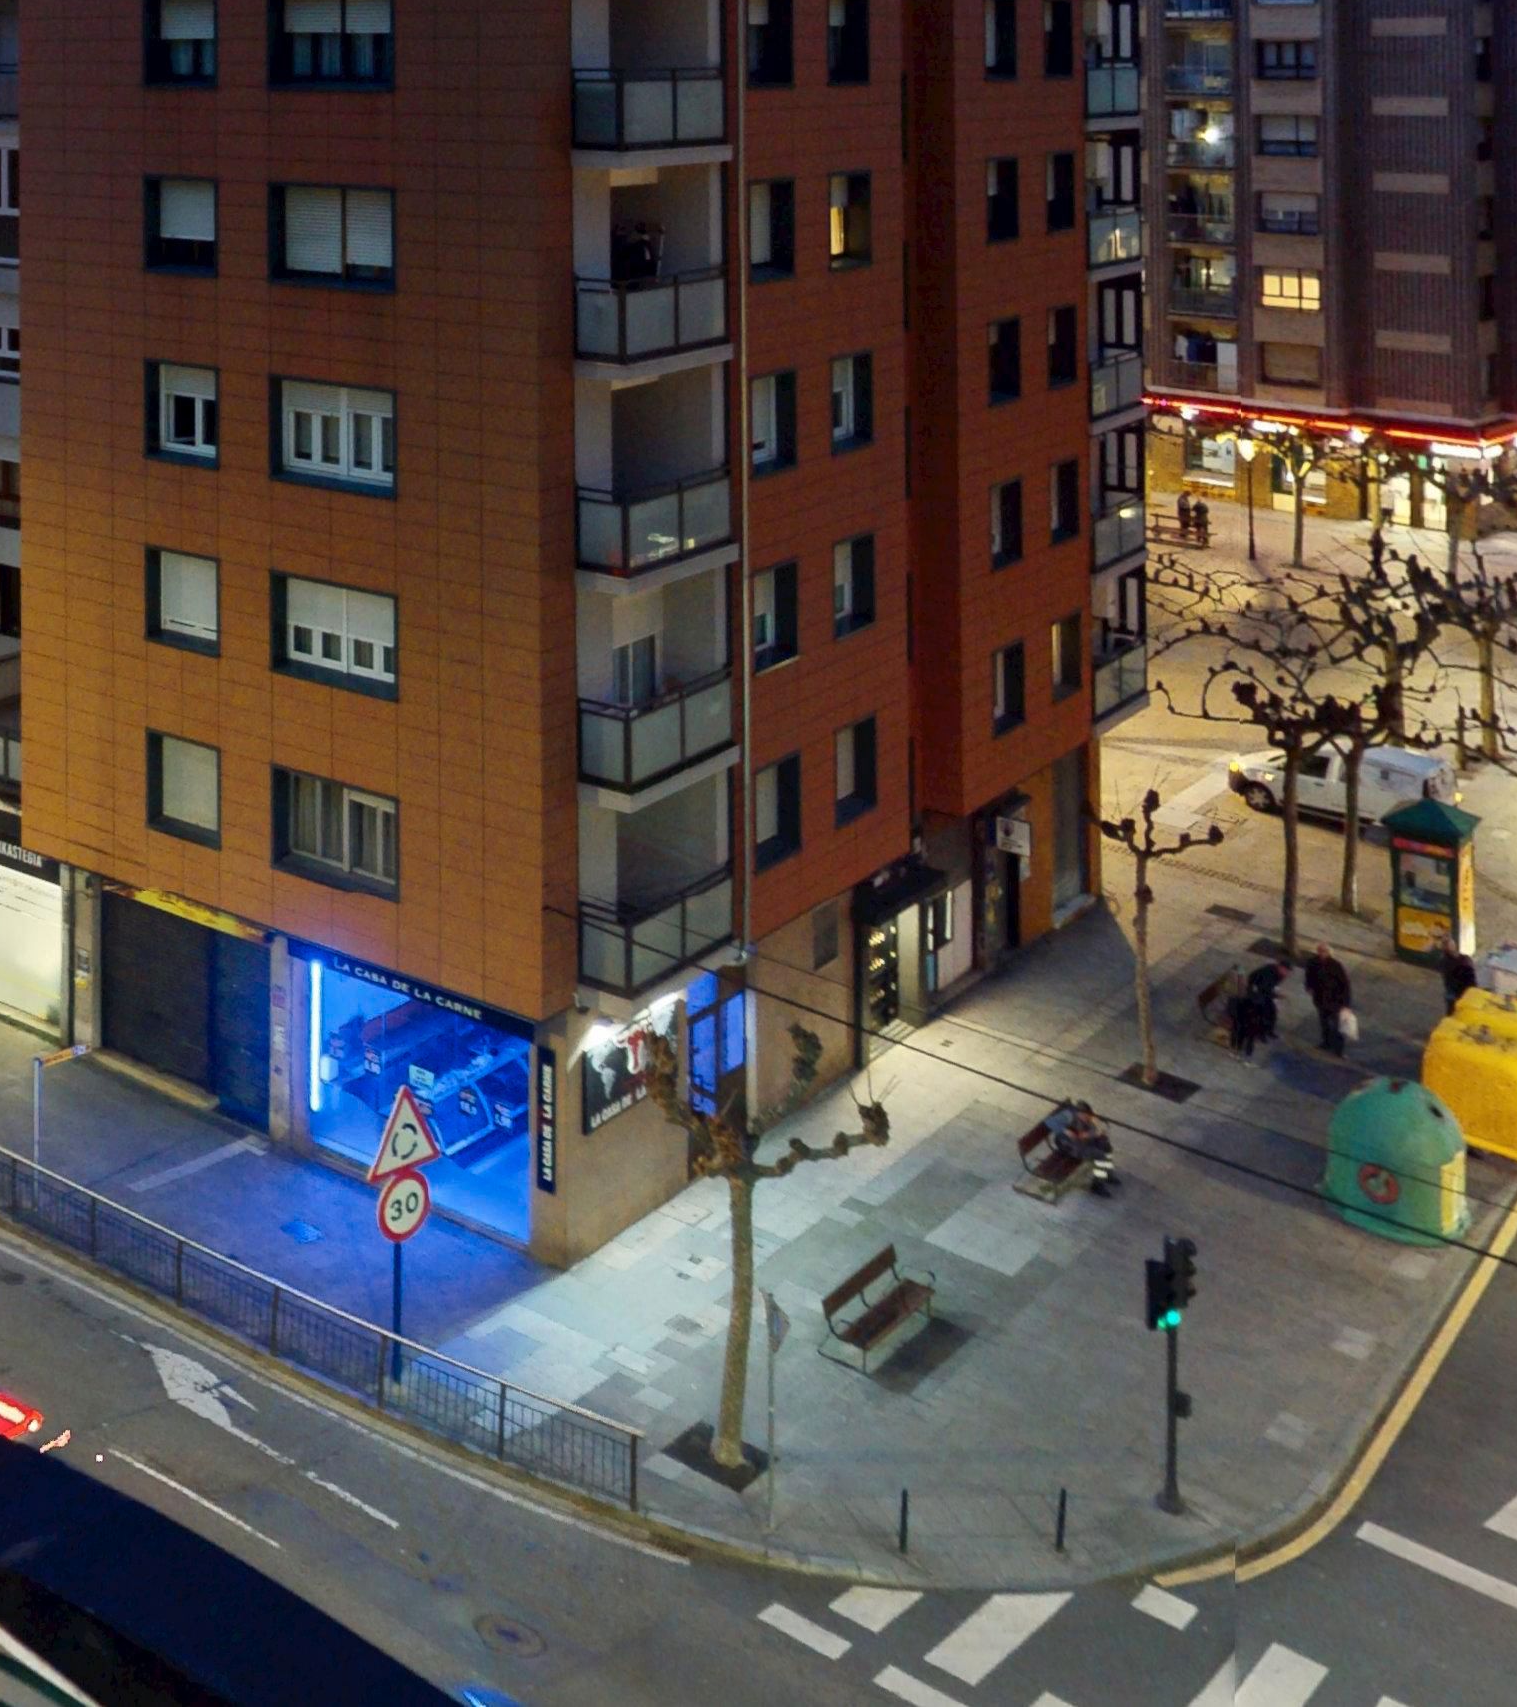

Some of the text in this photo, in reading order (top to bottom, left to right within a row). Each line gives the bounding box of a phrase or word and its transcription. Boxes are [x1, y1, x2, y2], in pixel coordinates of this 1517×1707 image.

[333, 956, 483, 1021] LA CASA DE LA CARNE
[389, 1191, 420, 1222] 30
